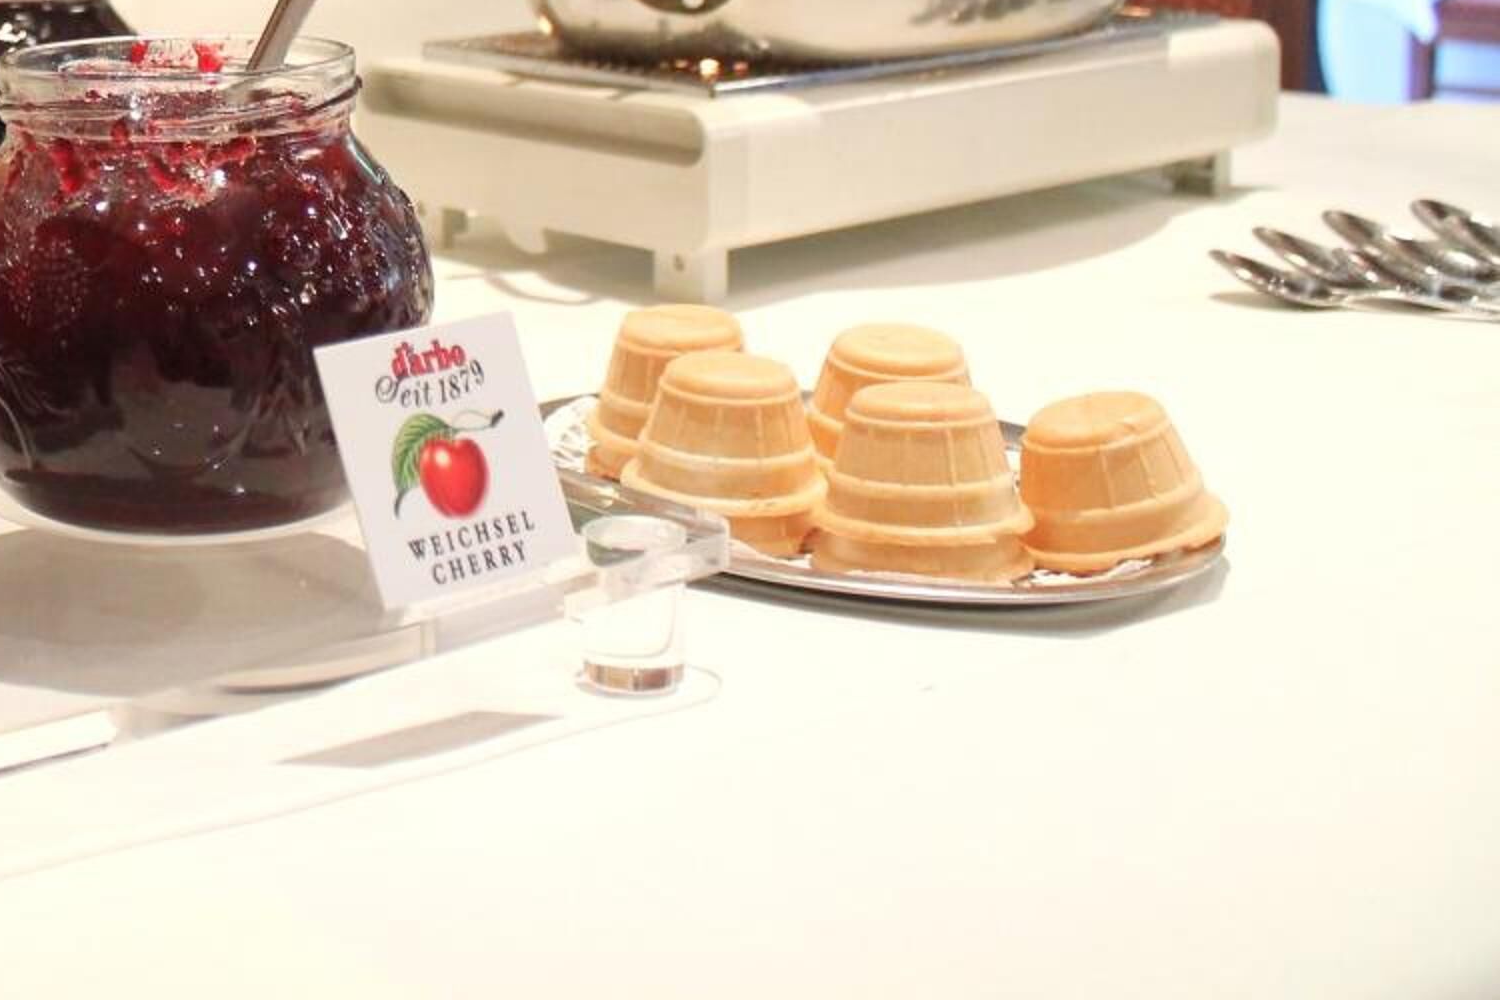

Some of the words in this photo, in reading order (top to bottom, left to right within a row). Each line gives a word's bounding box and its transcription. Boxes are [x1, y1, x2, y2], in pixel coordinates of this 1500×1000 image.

[375, 376, 432, 409] Seit
[438, 360, 485, 405] 1879
[407, 510, 536, 561] WEICHSEL
[432, 540, 527, 586] CHERRY
